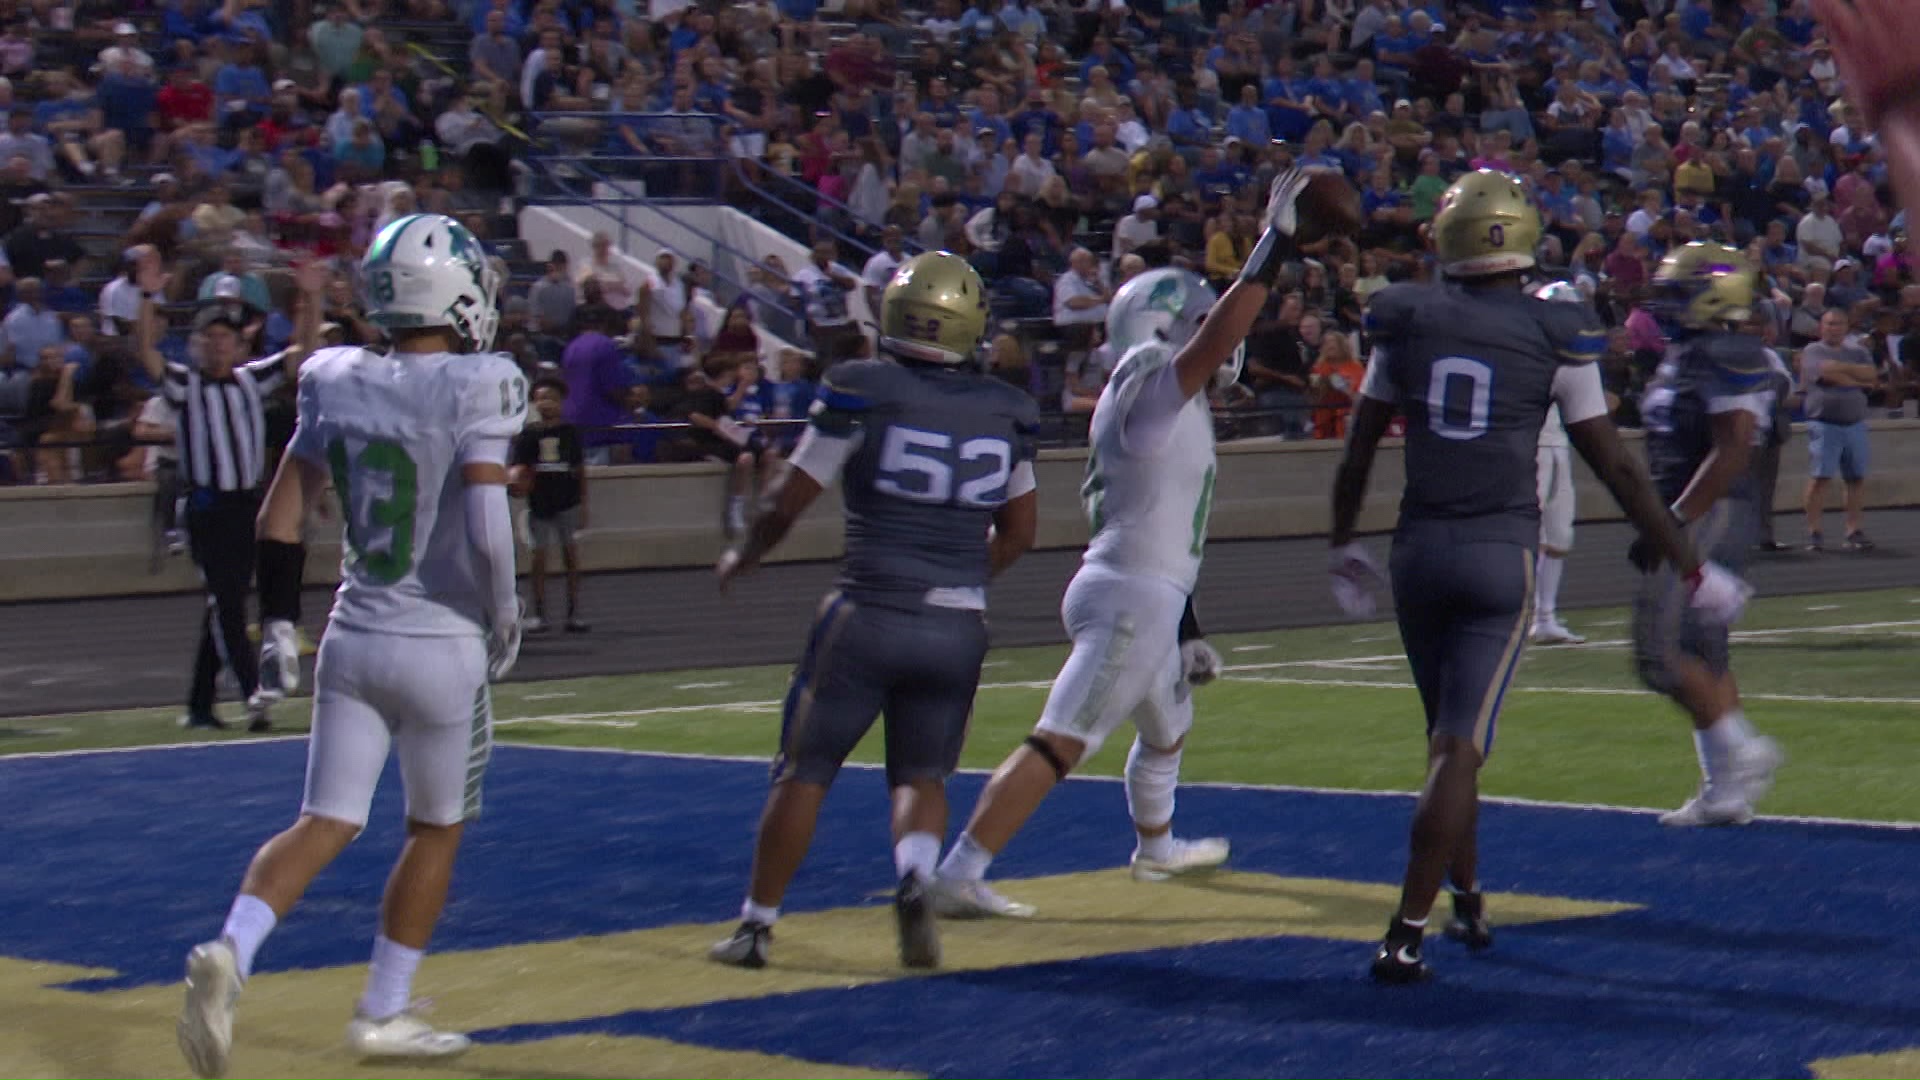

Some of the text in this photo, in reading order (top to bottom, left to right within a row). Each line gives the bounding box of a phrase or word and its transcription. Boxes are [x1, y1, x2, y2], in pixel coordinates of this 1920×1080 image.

[499, 377, 525, 416] 13
[1427, 355, 1494, 441] 0
[873, 424, 1012, 507] 52
[329, 436, 417, 584] 13
